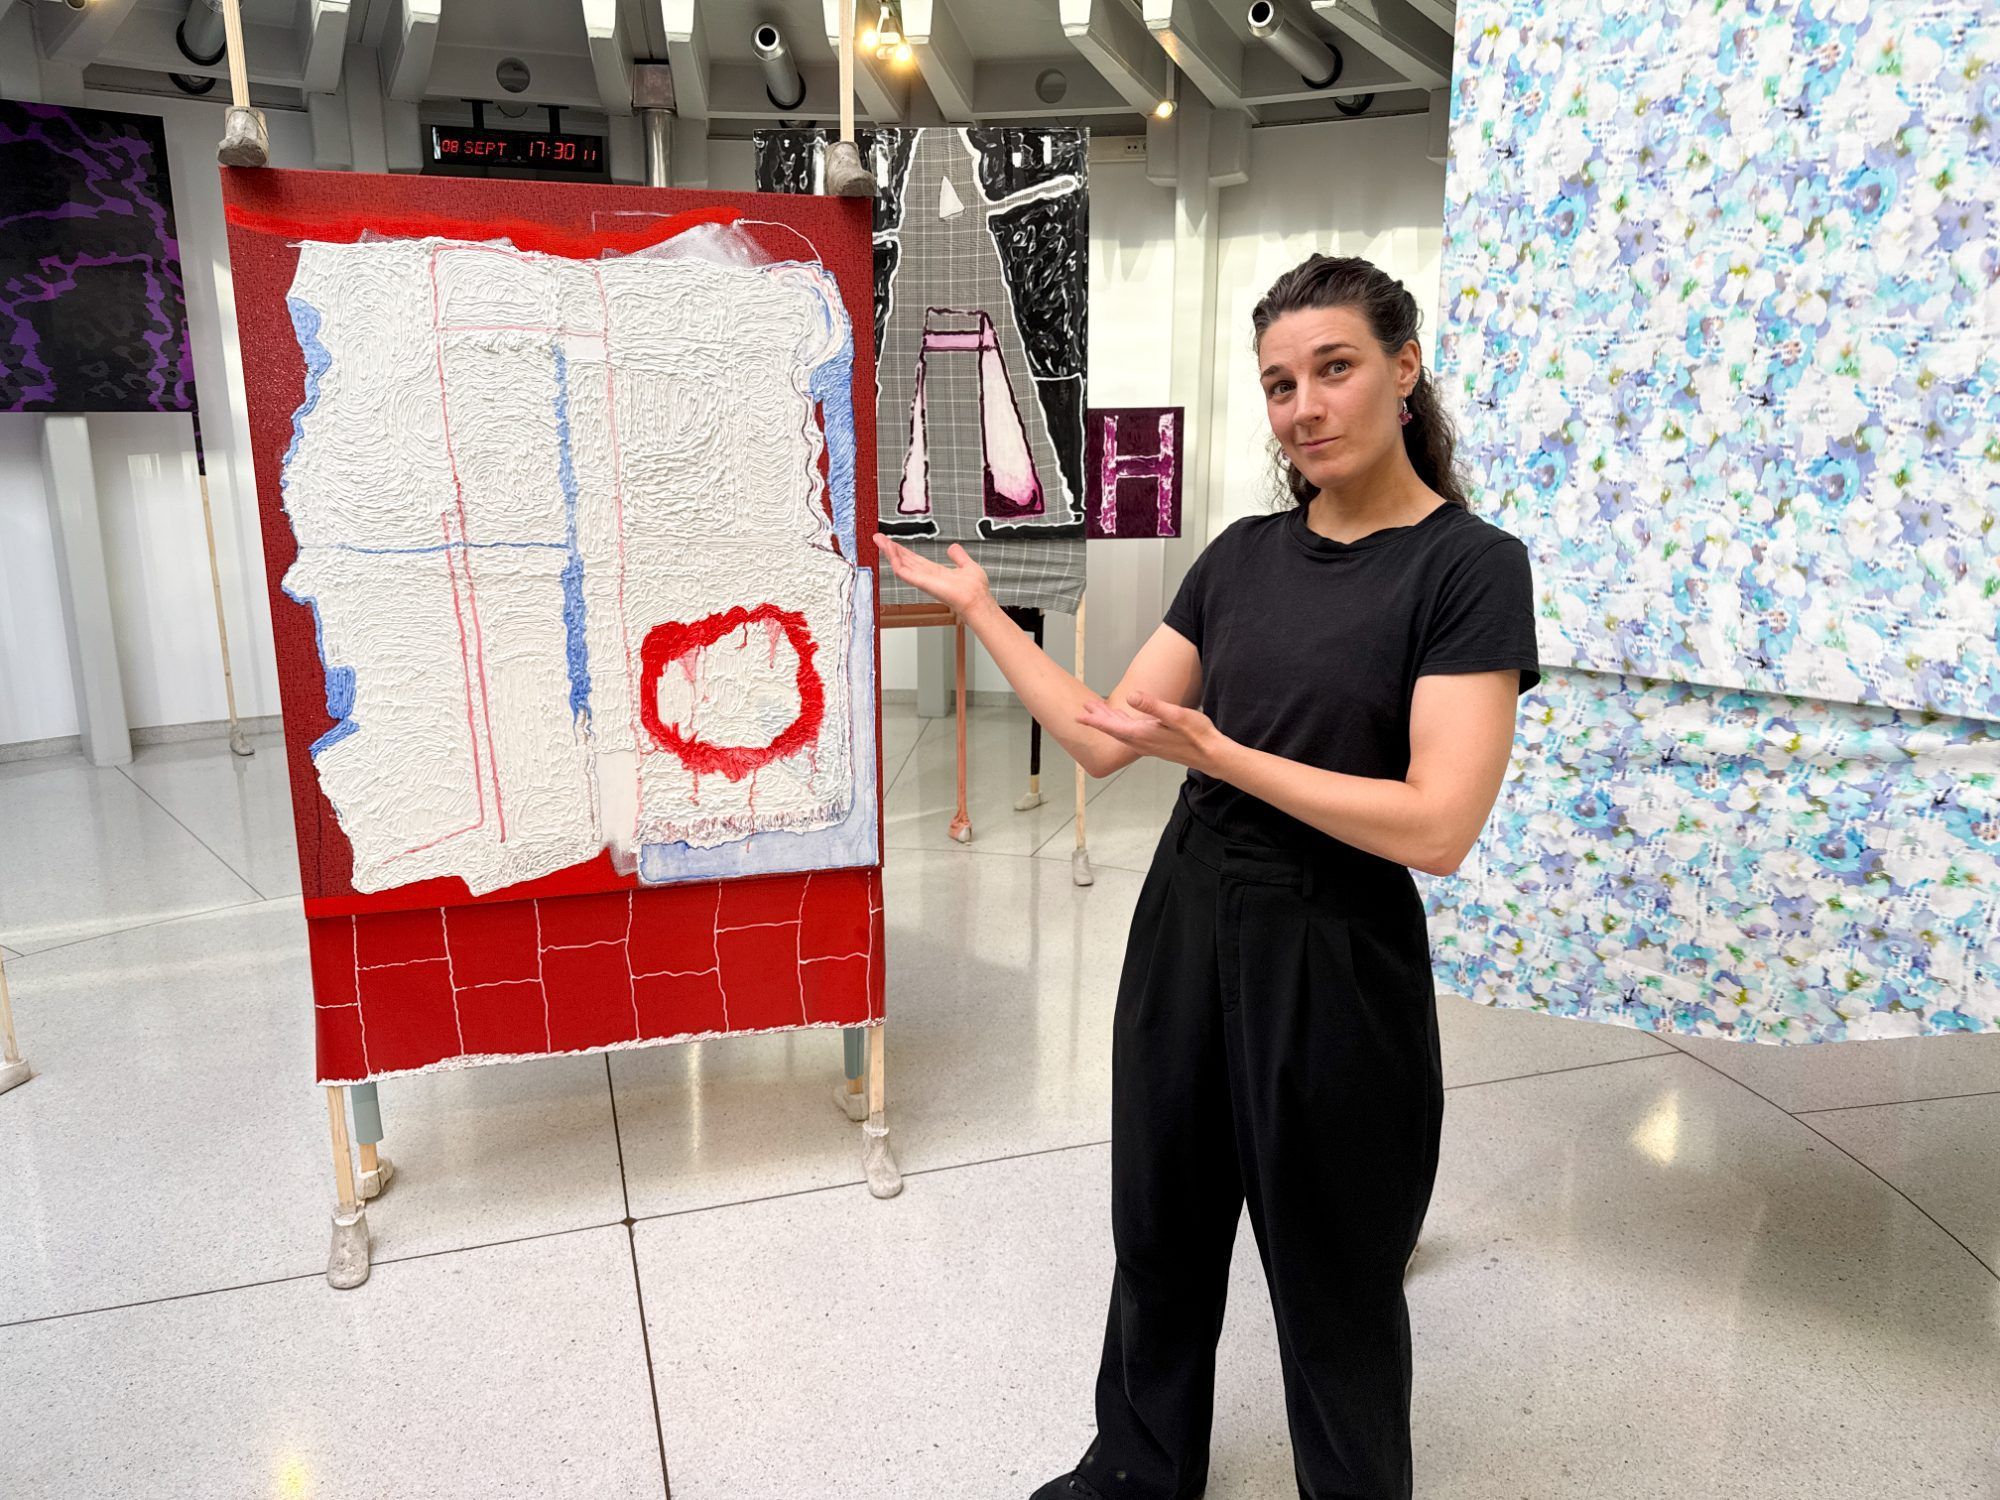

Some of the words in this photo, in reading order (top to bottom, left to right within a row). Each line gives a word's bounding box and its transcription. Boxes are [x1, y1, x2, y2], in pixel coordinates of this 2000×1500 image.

[441, 139, 459, 153] 08
[464, 140, 507, 156] SEPT
[529, 141, 576, 161] 17:30
